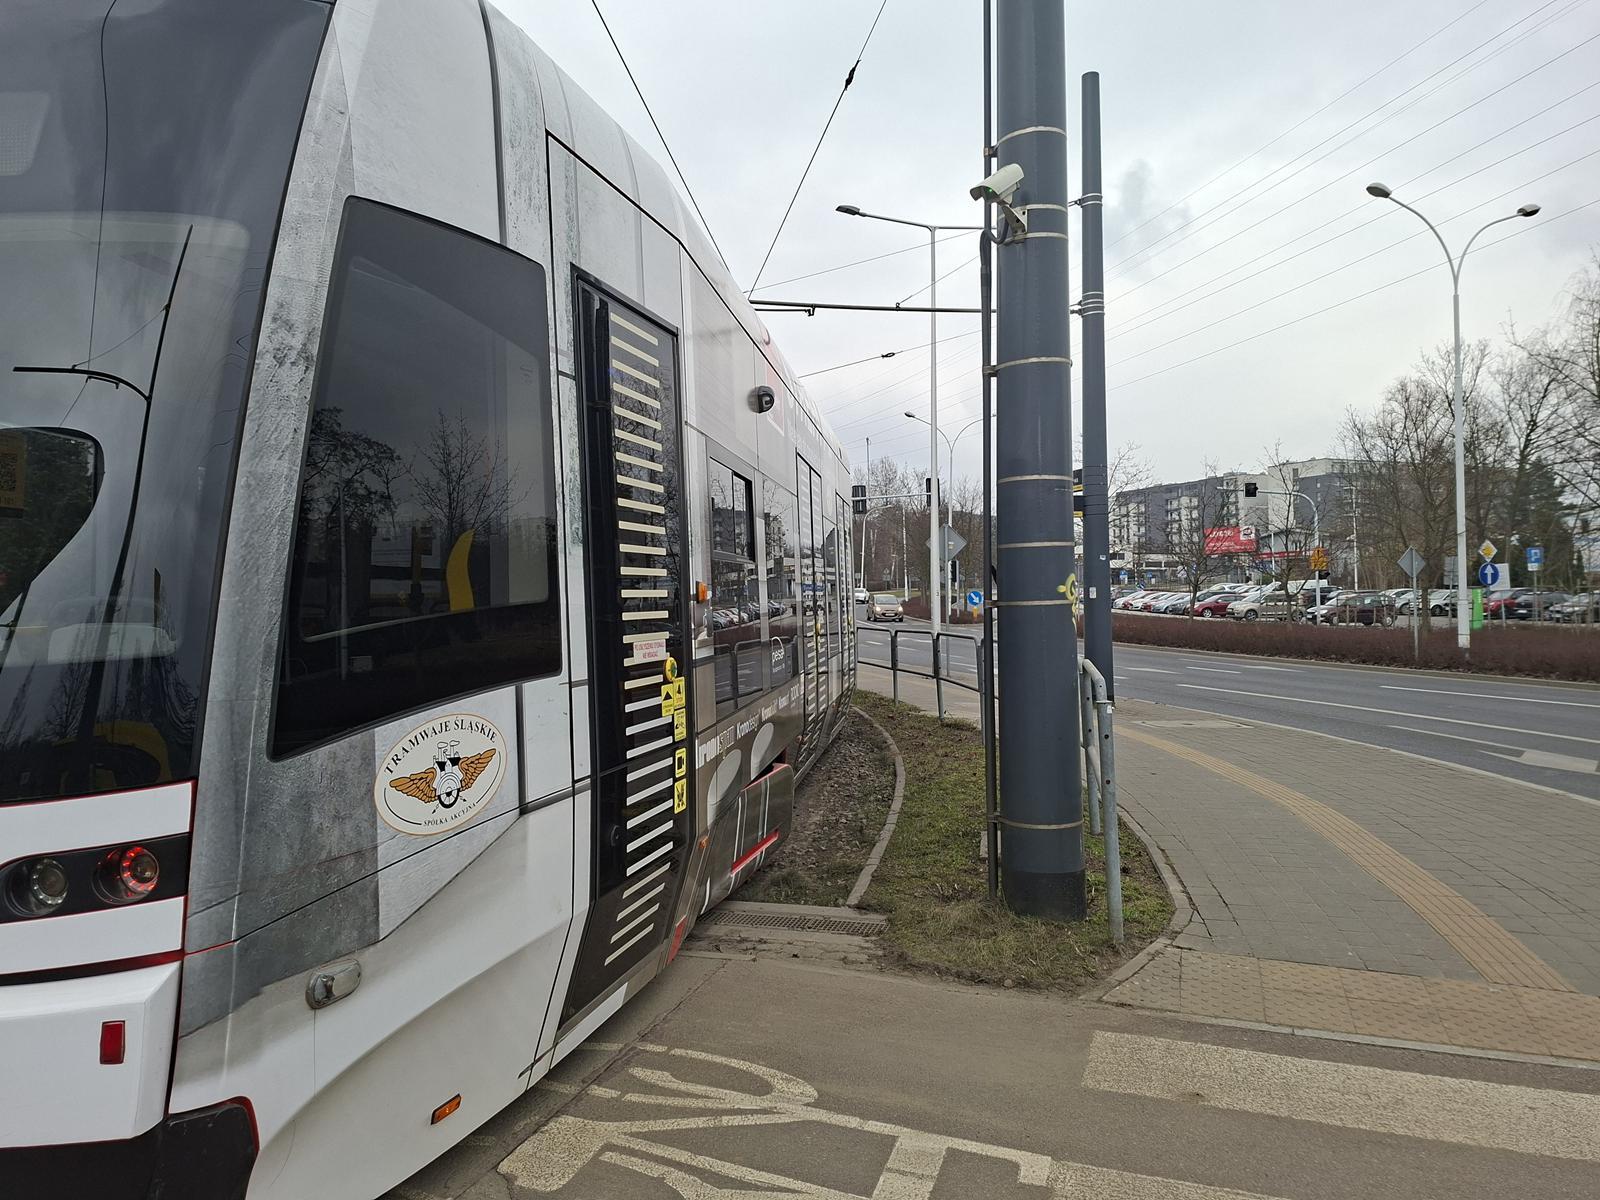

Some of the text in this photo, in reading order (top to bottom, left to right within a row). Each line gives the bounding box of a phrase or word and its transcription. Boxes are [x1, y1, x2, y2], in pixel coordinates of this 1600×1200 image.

[384, 716, 497, 775] TRAMWAJE ŚLĄSKIE
[423, 802, 477, 827] SPÓŁKA AKCYJNA
